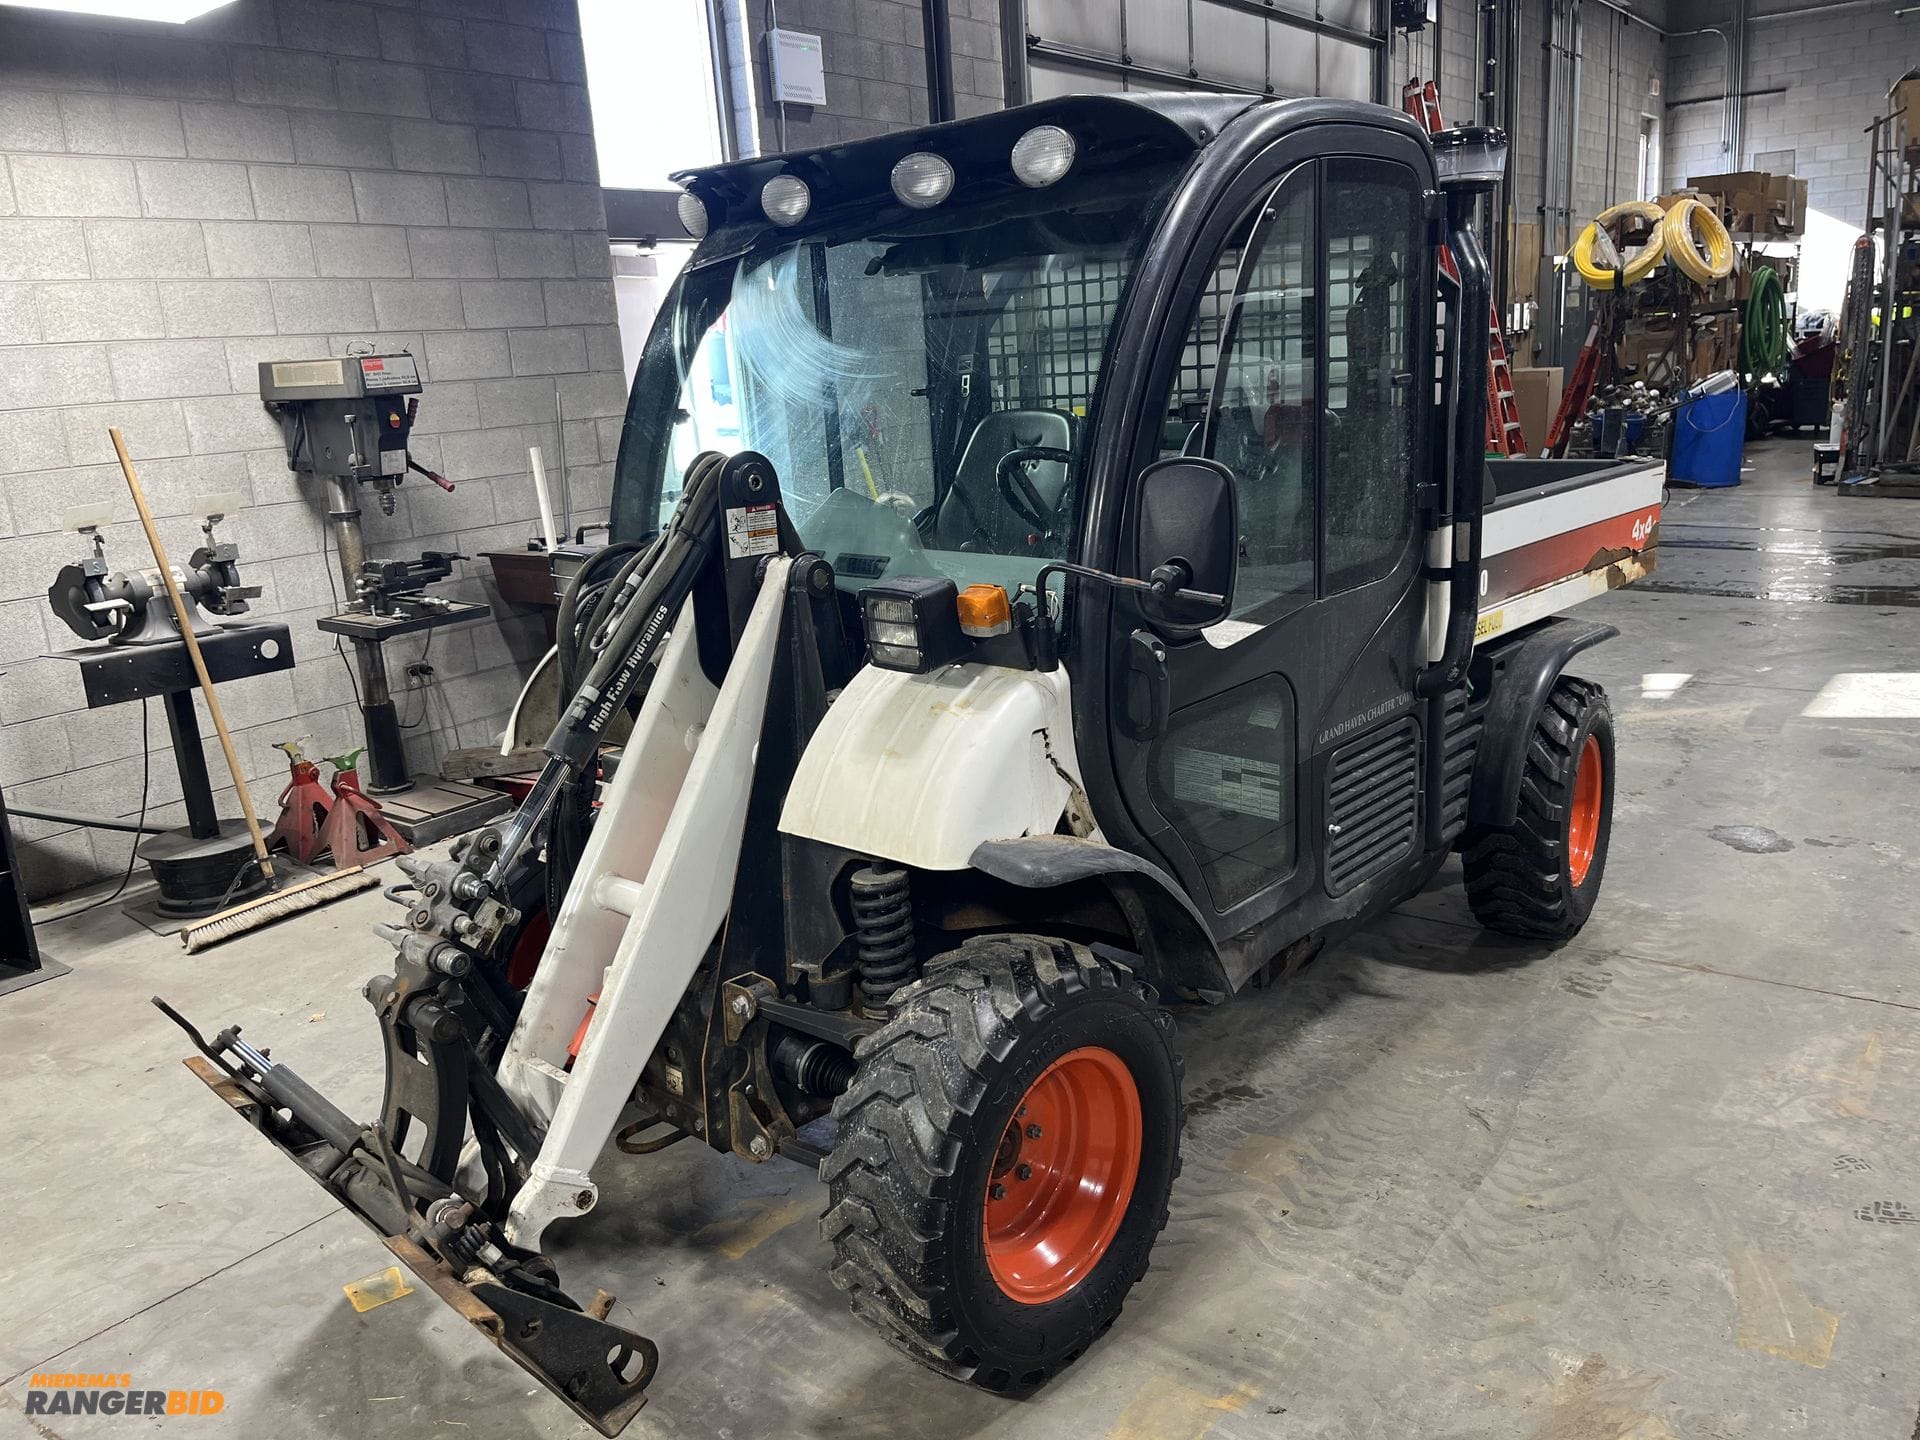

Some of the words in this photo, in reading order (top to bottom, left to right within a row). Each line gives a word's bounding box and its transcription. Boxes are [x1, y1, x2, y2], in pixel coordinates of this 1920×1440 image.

[1631, 514, 1656, 541] 4x4
[588, 700, 613, 732] High
[626, 605, 668, 669] Hydraulics
[1319, 723, 1344, 744] GRAND
[1344, 713, 1367, 733] HAVEN
